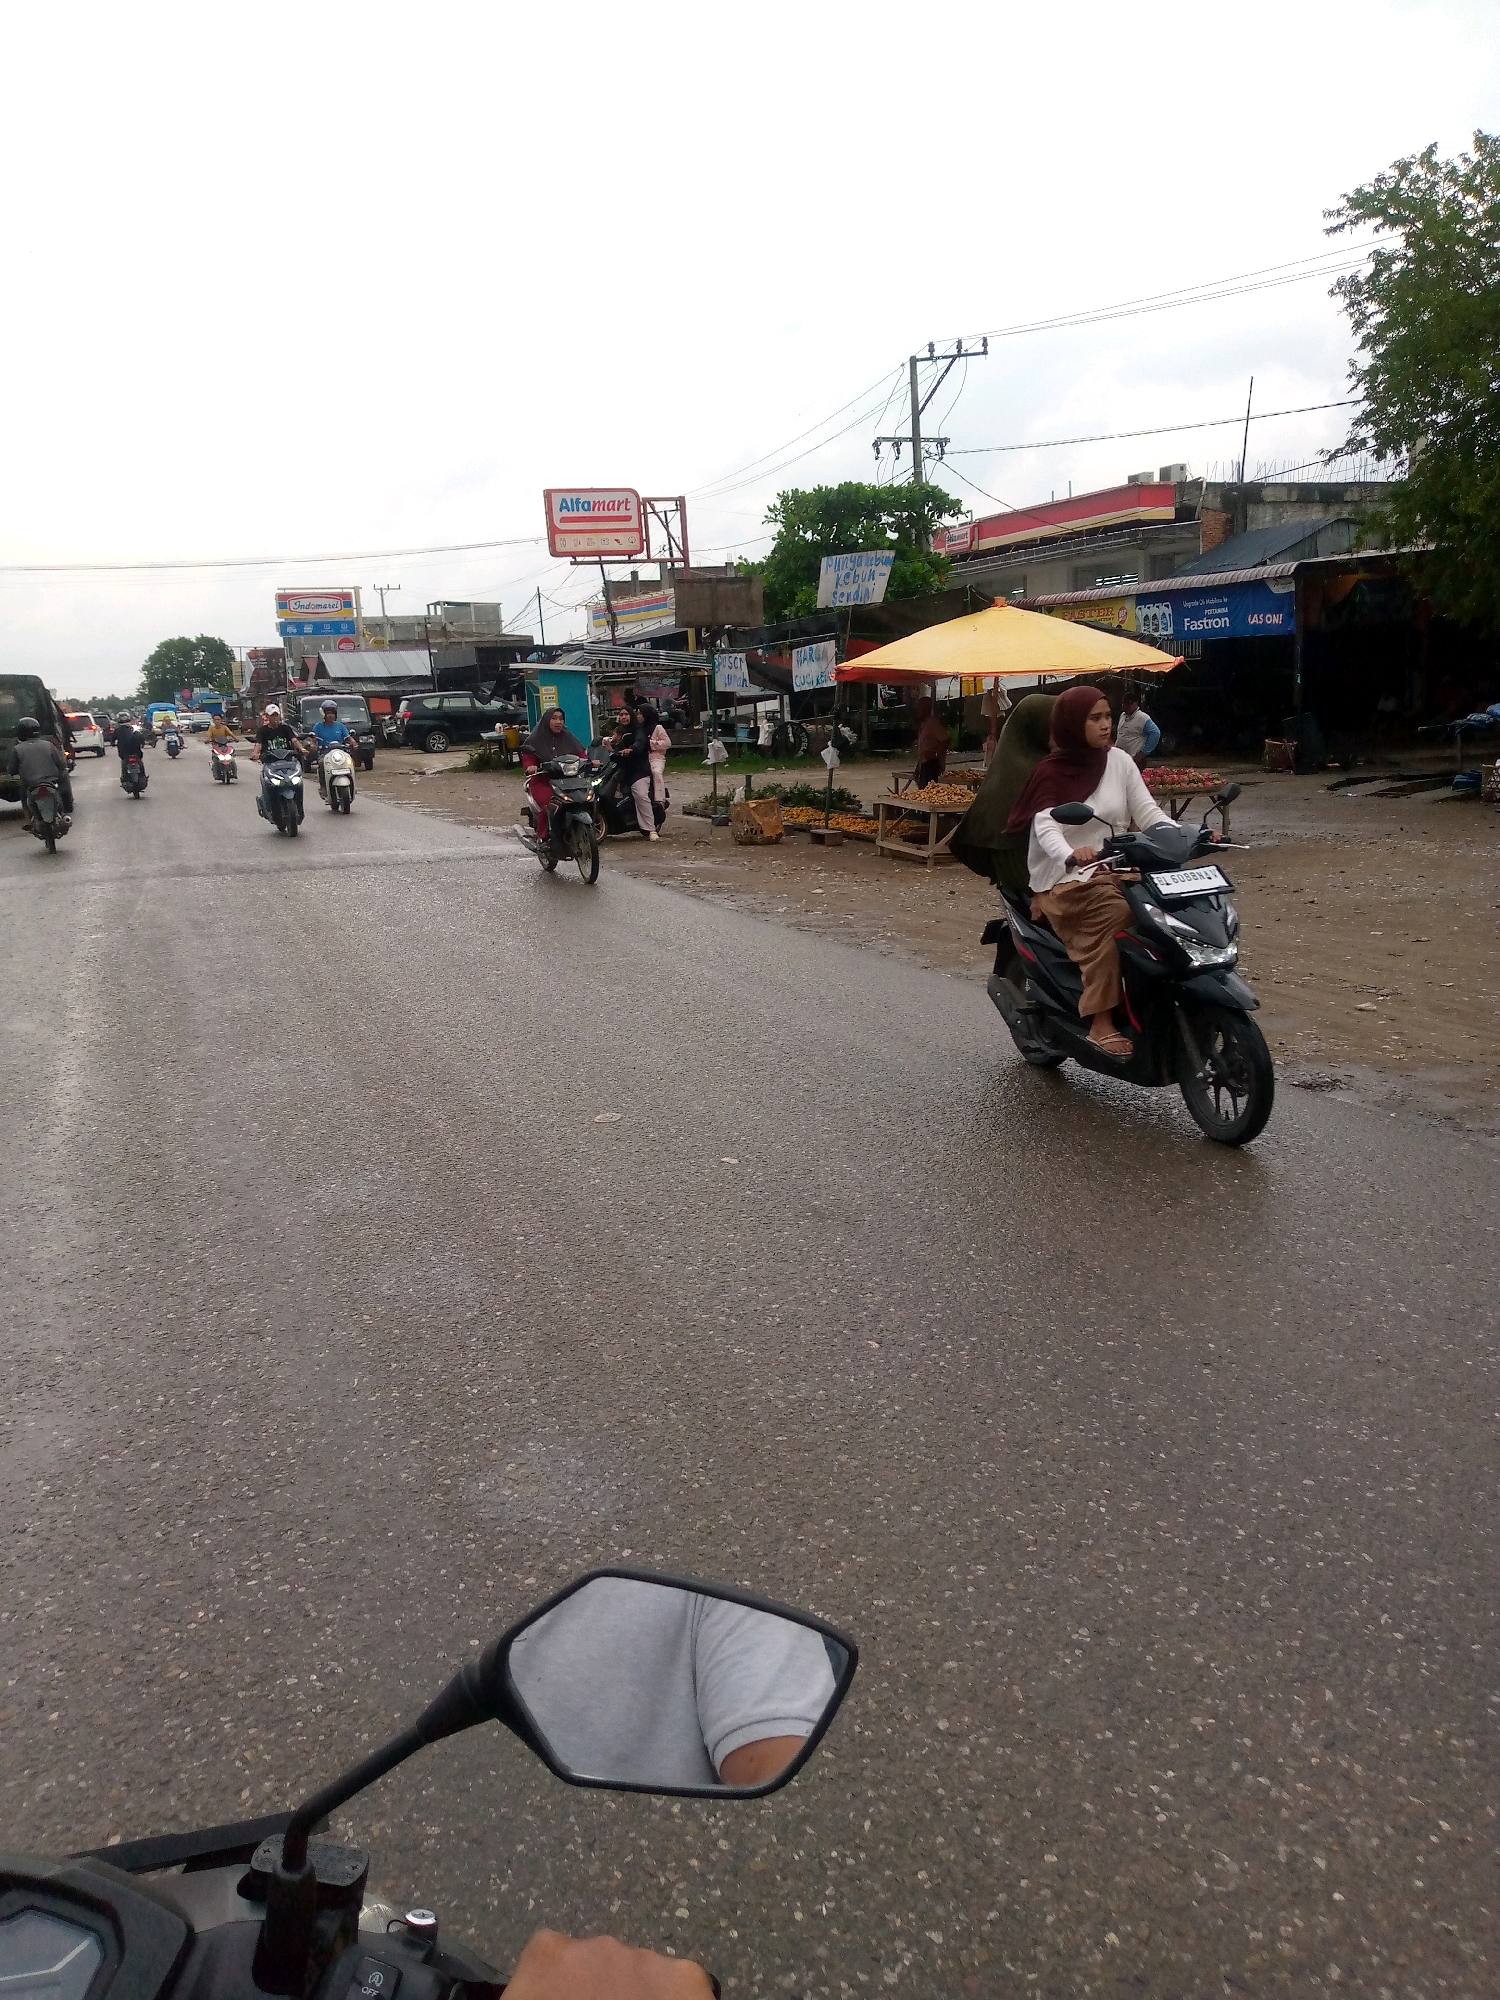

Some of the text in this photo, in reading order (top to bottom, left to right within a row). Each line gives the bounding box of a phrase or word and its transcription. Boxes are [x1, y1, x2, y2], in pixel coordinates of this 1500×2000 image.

[559, 497, 631, 512] Alfamart
[292, 600, 339, 611] Indomaret
[1061, 607, 1115, 620] FASTER
[1265, 613, 1283, 624] ON!
[1183, 617, 1230, 631] Fastron
[361, 1986, 380, 1997] OFF
